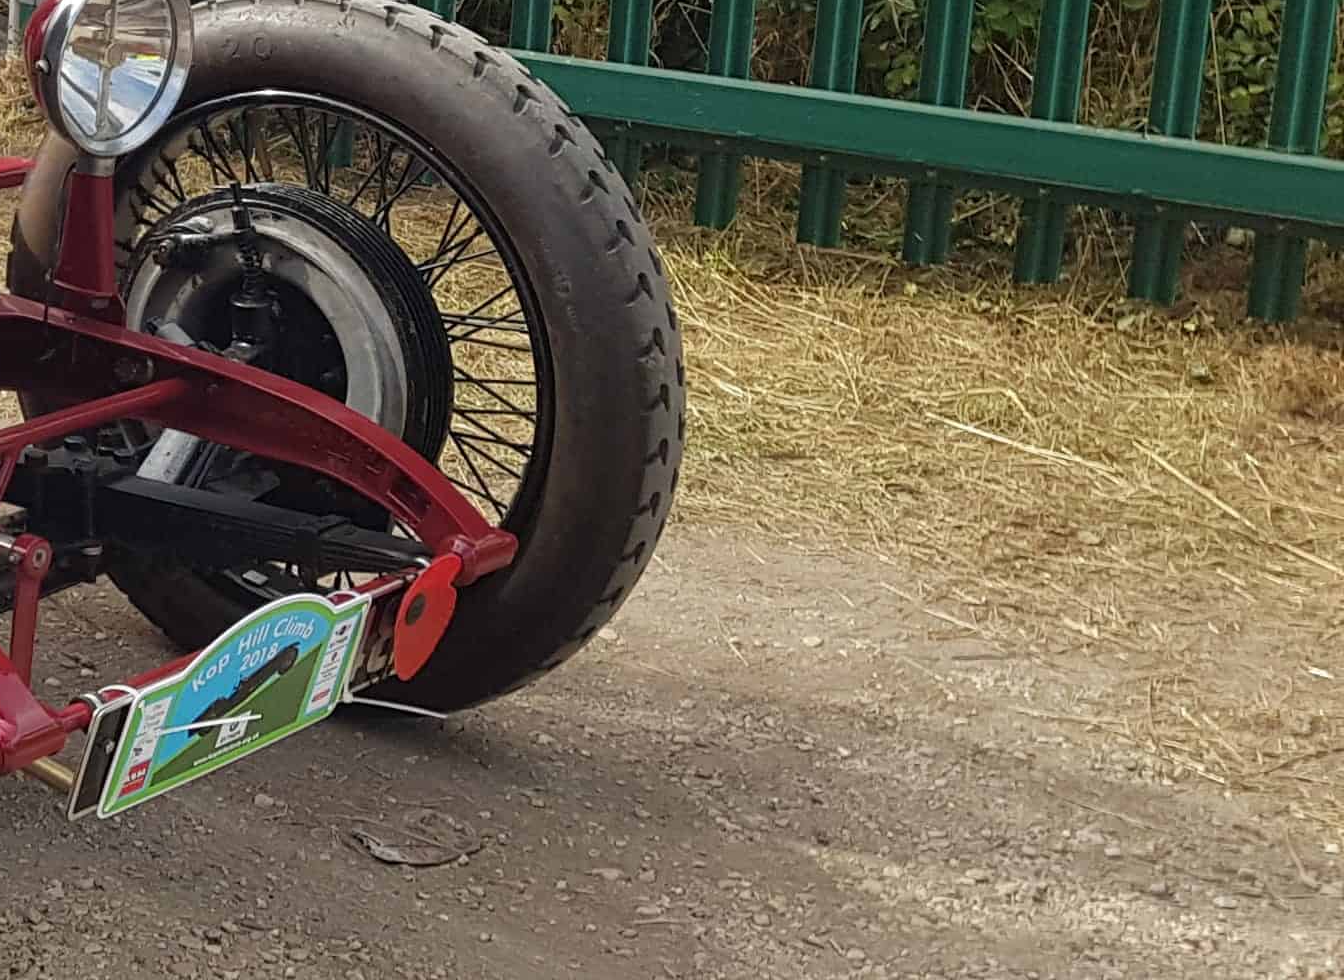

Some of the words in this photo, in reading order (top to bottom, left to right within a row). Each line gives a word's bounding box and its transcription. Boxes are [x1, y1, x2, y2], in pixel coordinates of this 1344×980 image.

[192, 653, 230, 693] Kop
[238, 622, 271, 656] Hill
[273, 615, 315, 639] Climb
[240, 641, 281, 672] 2018
